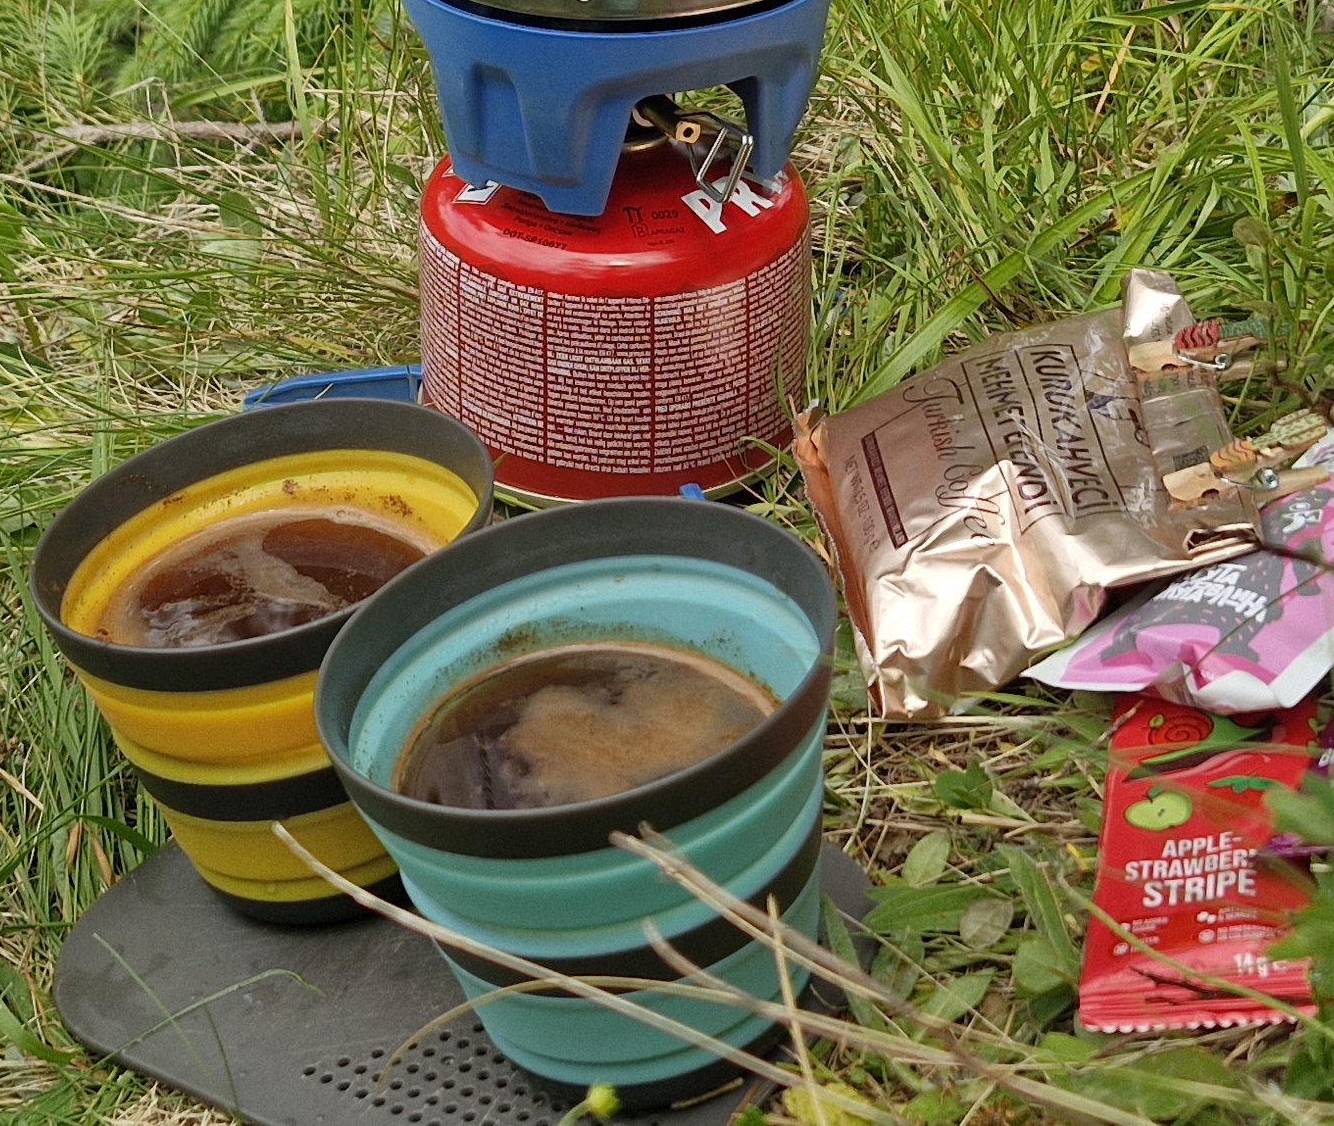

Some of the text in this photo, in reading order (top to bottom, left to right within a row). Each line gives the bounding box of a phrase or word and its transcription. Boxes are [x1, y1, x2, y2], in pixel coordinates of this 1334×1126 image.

[976, 357, 1026, 427] MEHMET
[1030, 350, 1119, 512] KURUKAHVECİ
[902, 377, 1006, 548] Turkish Coffee
[1125, 848, 1258, 881] STRAWBER
[1161, 831, 1243, 858] APPLE-
[1142, 869, 1257, 908] STRIPE
